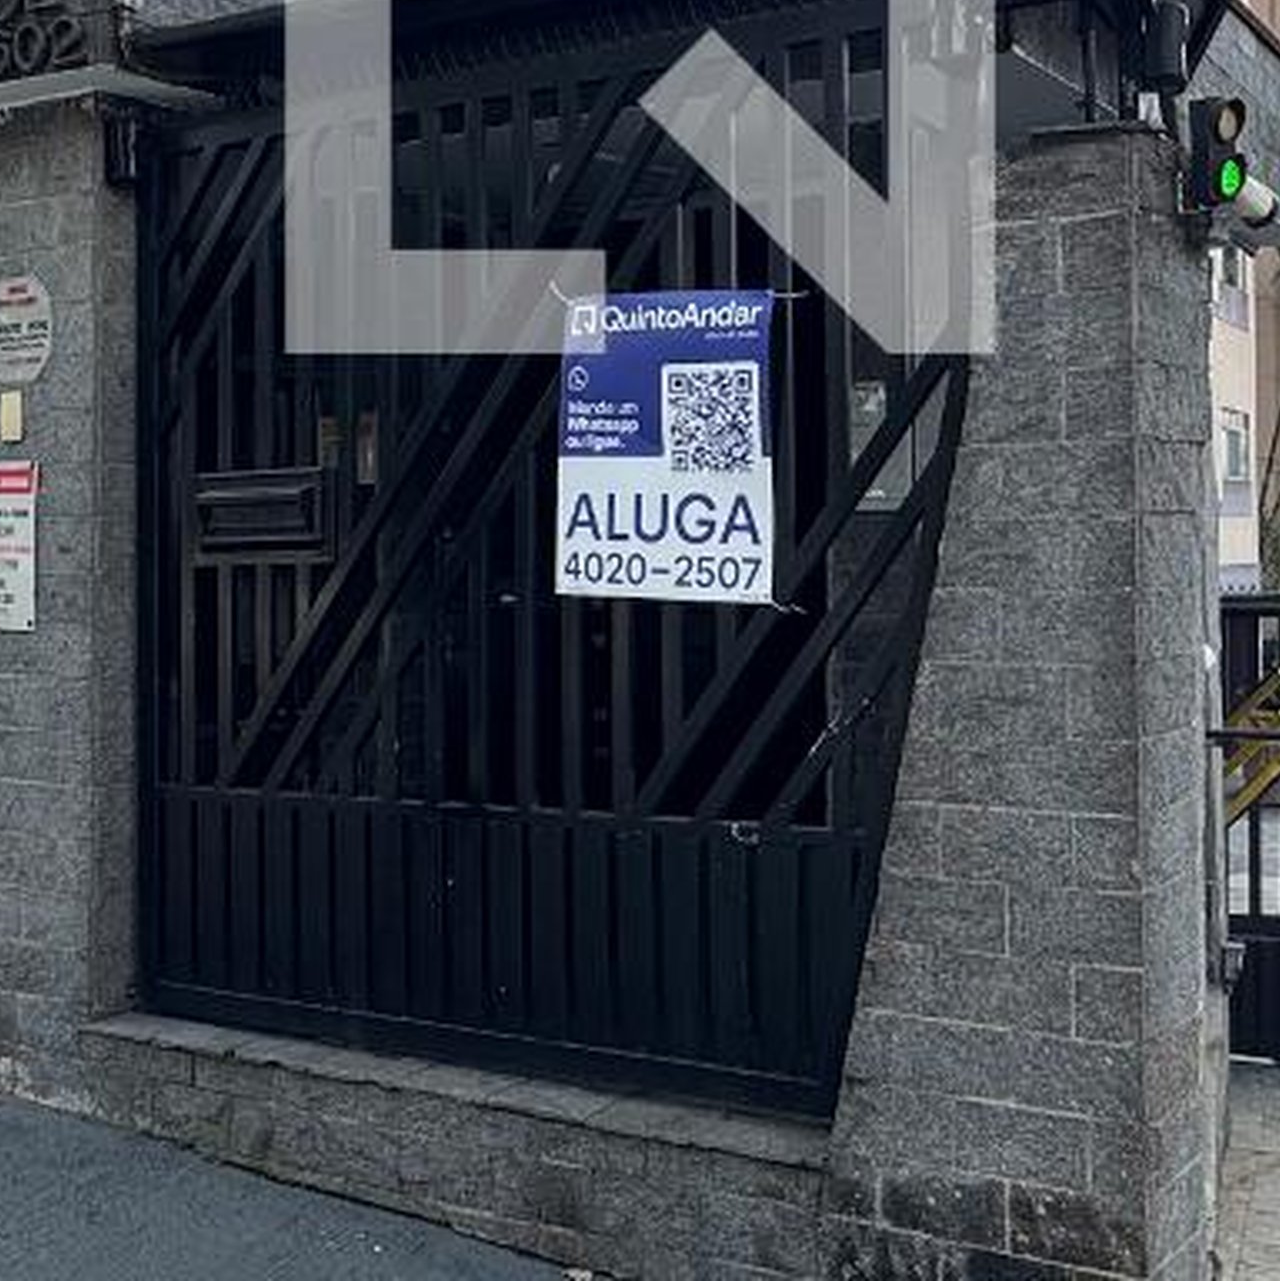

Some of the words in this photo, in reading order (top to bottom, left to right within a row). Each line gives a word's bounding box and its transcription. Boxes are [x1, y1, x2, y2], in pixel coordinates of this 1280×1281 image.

[601, 300, 763, 331] QuintoAndar
[565, 492, 762, 545] ALUGA
[564, 552, 763, 591] 4020-2507
